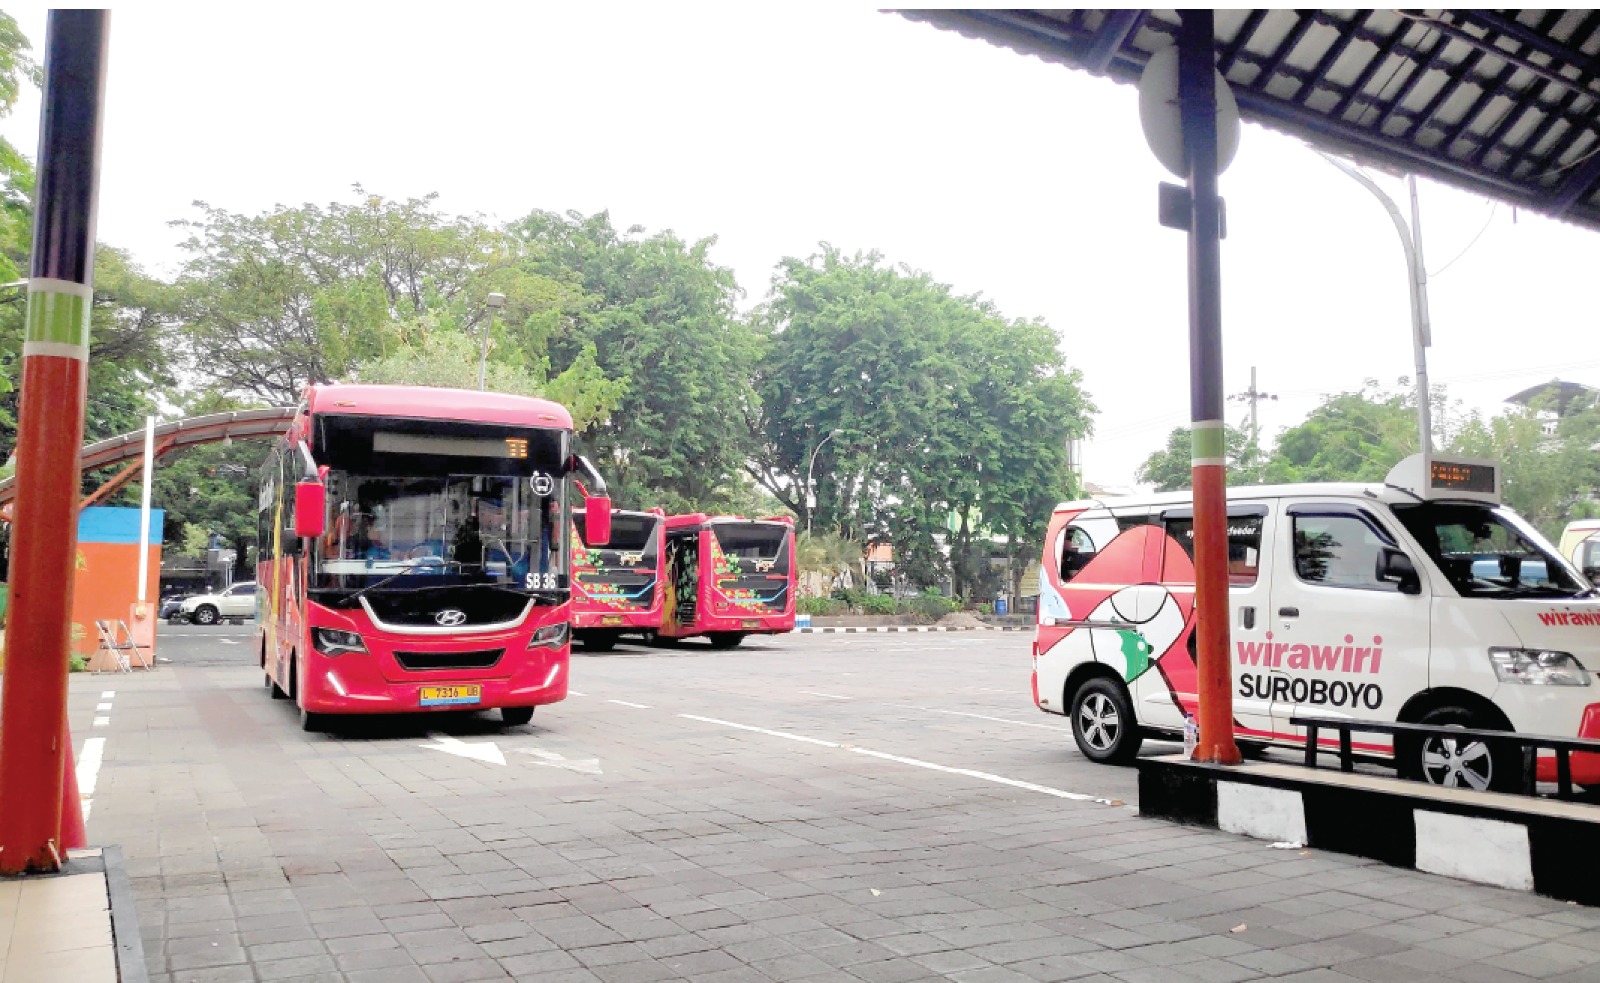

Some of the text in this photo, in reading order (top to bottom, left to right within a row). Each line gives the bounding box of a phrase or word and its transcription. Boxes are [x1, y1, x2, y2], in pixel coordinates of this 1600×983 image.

[526, 572, 556, 589] SB 36
[1237, 630, 1383, 674] wirawiri
[423, 689, 429, 699] L
[1238, 672, 1384, 710] SUROBOYO
